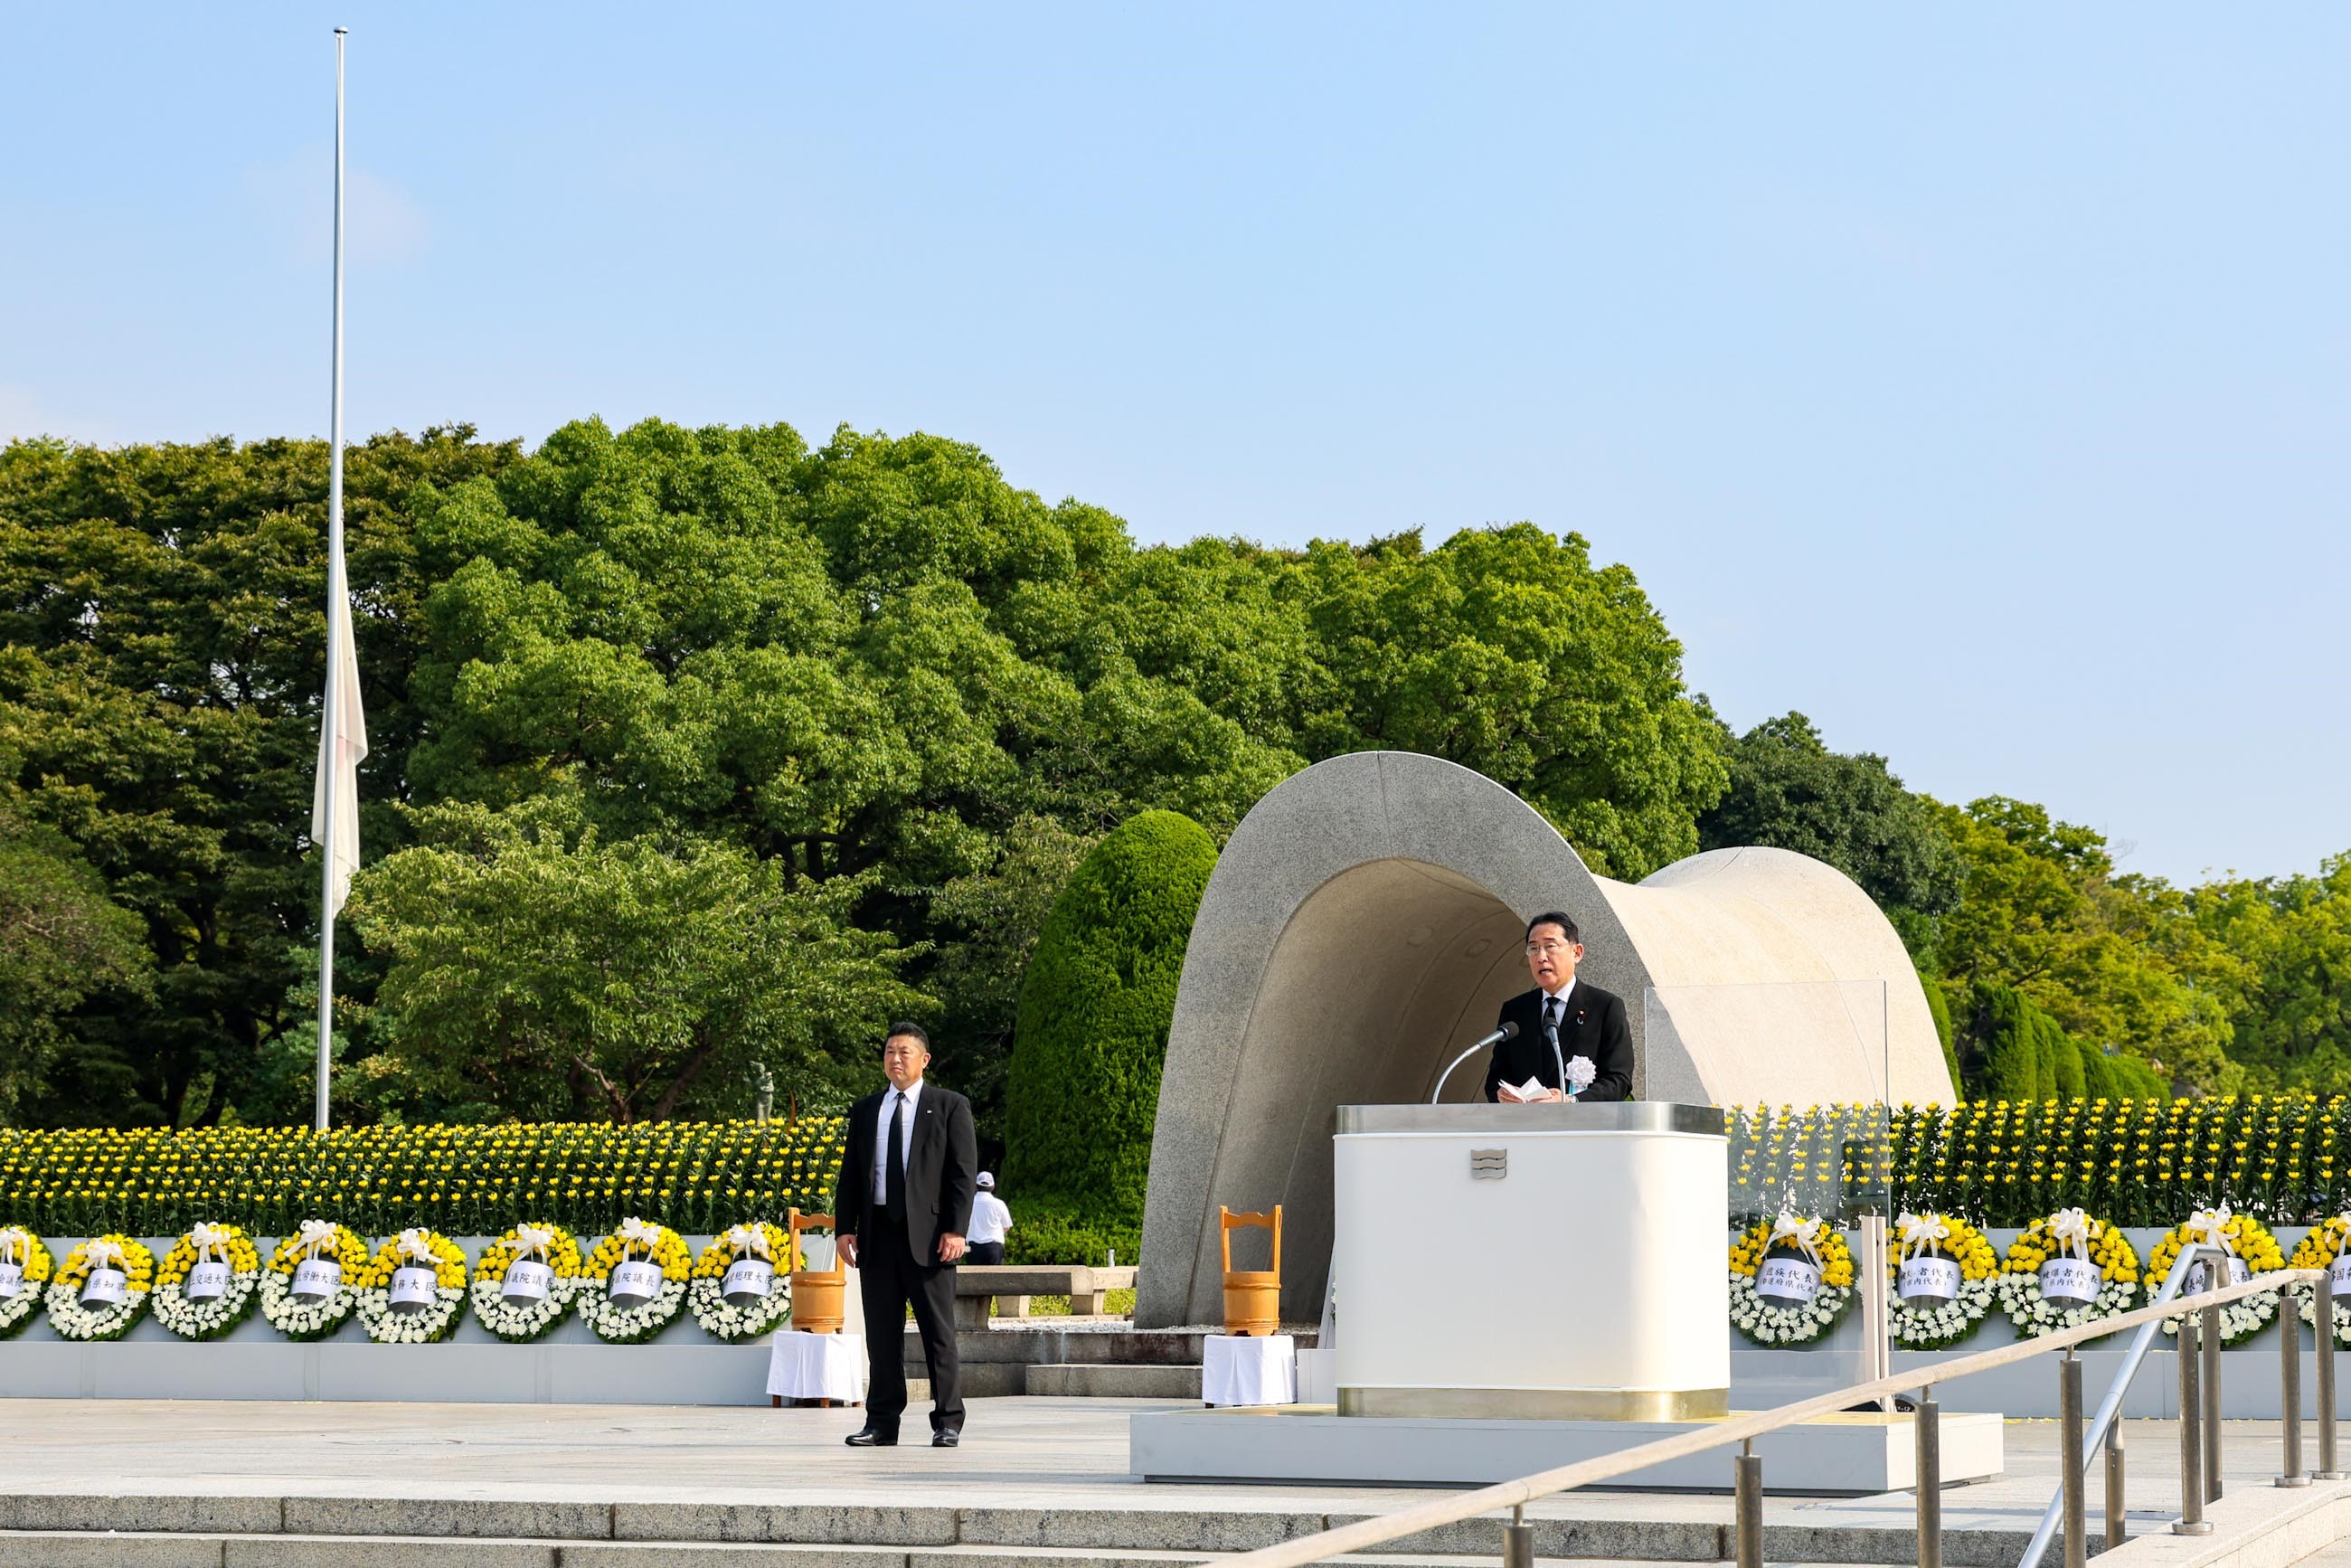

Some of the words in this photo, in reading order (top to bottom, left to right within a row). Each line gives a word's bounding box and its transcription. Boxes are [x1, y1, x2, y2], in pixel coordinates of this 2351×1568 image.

[2043, 1267, 2098, 1284] 被爆者代表
